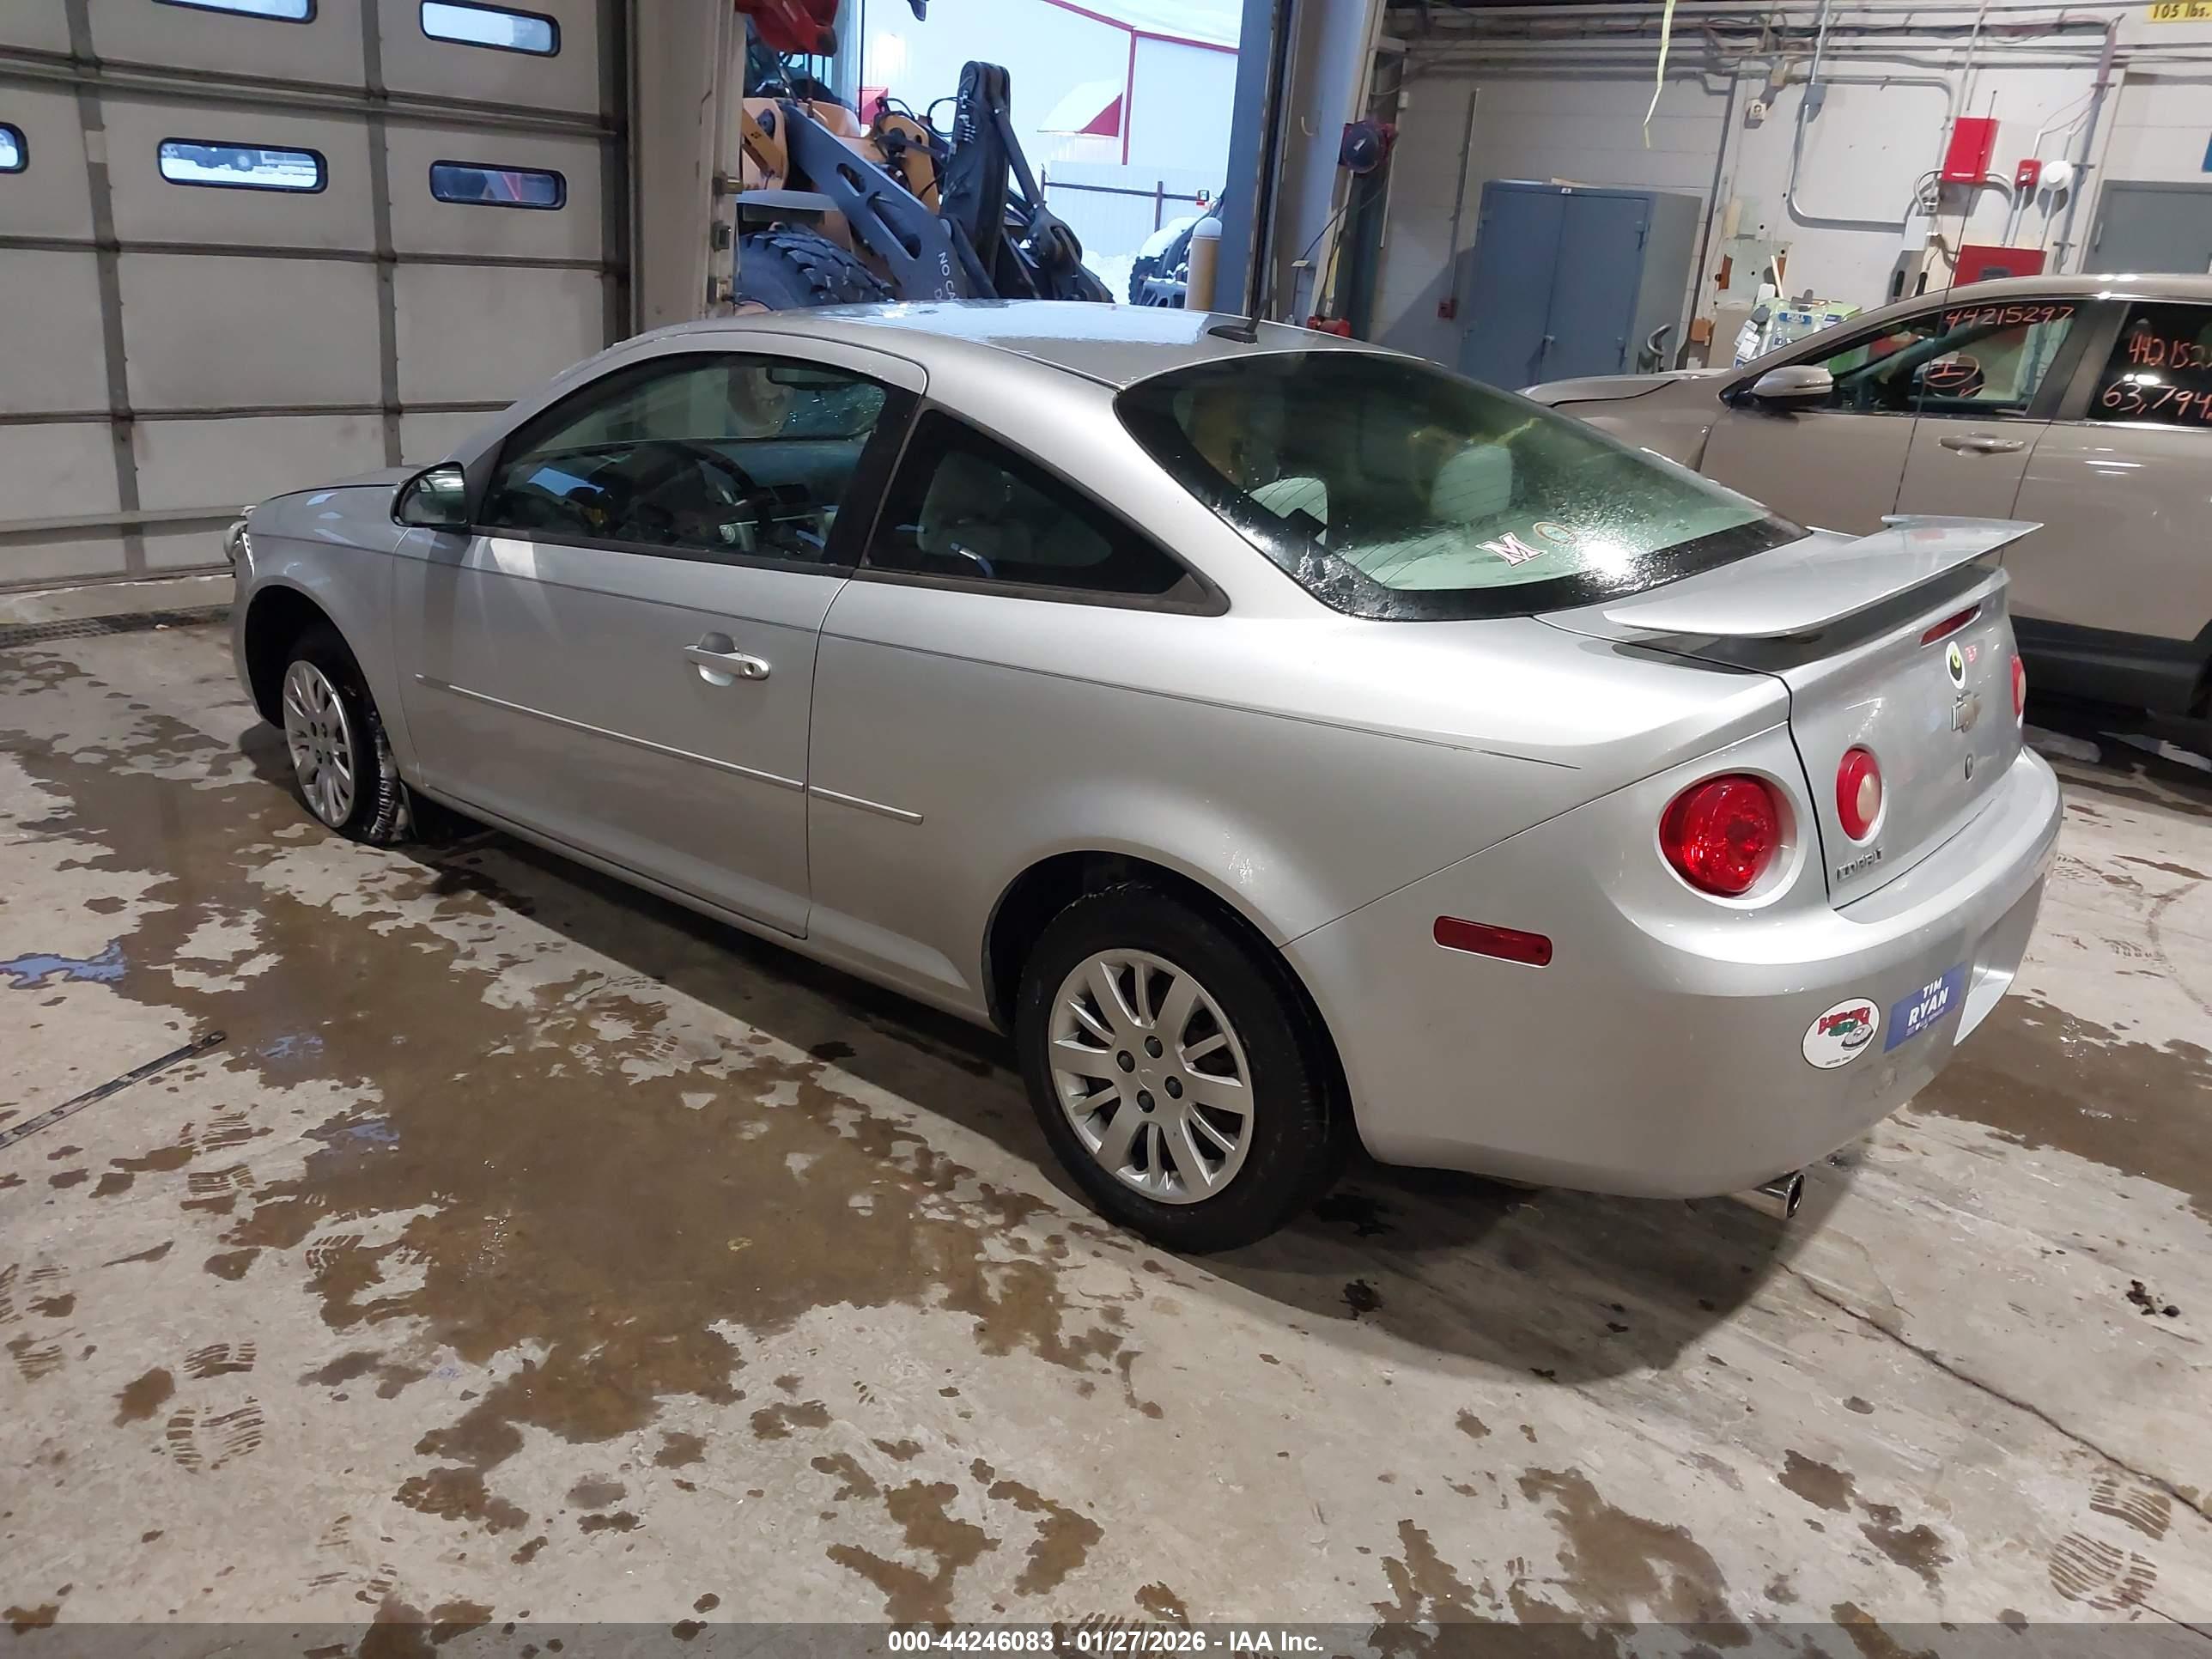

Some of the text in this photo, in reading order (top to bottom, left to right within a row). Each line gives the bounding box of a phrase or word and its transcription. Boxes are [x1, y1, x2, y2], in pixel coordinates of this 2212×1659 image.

[2153, 4, 2180, 19] 105
[938, 252, 951, 276] NO
[1945, 307, 2075, 330] 44215297
[2130, 331, 2212, 370] 442152
[1475, 532, 1548, 568] M
[1923, 976, 1942, 1000] TIM
[1908, 986, 1949, 1027] RYAN
